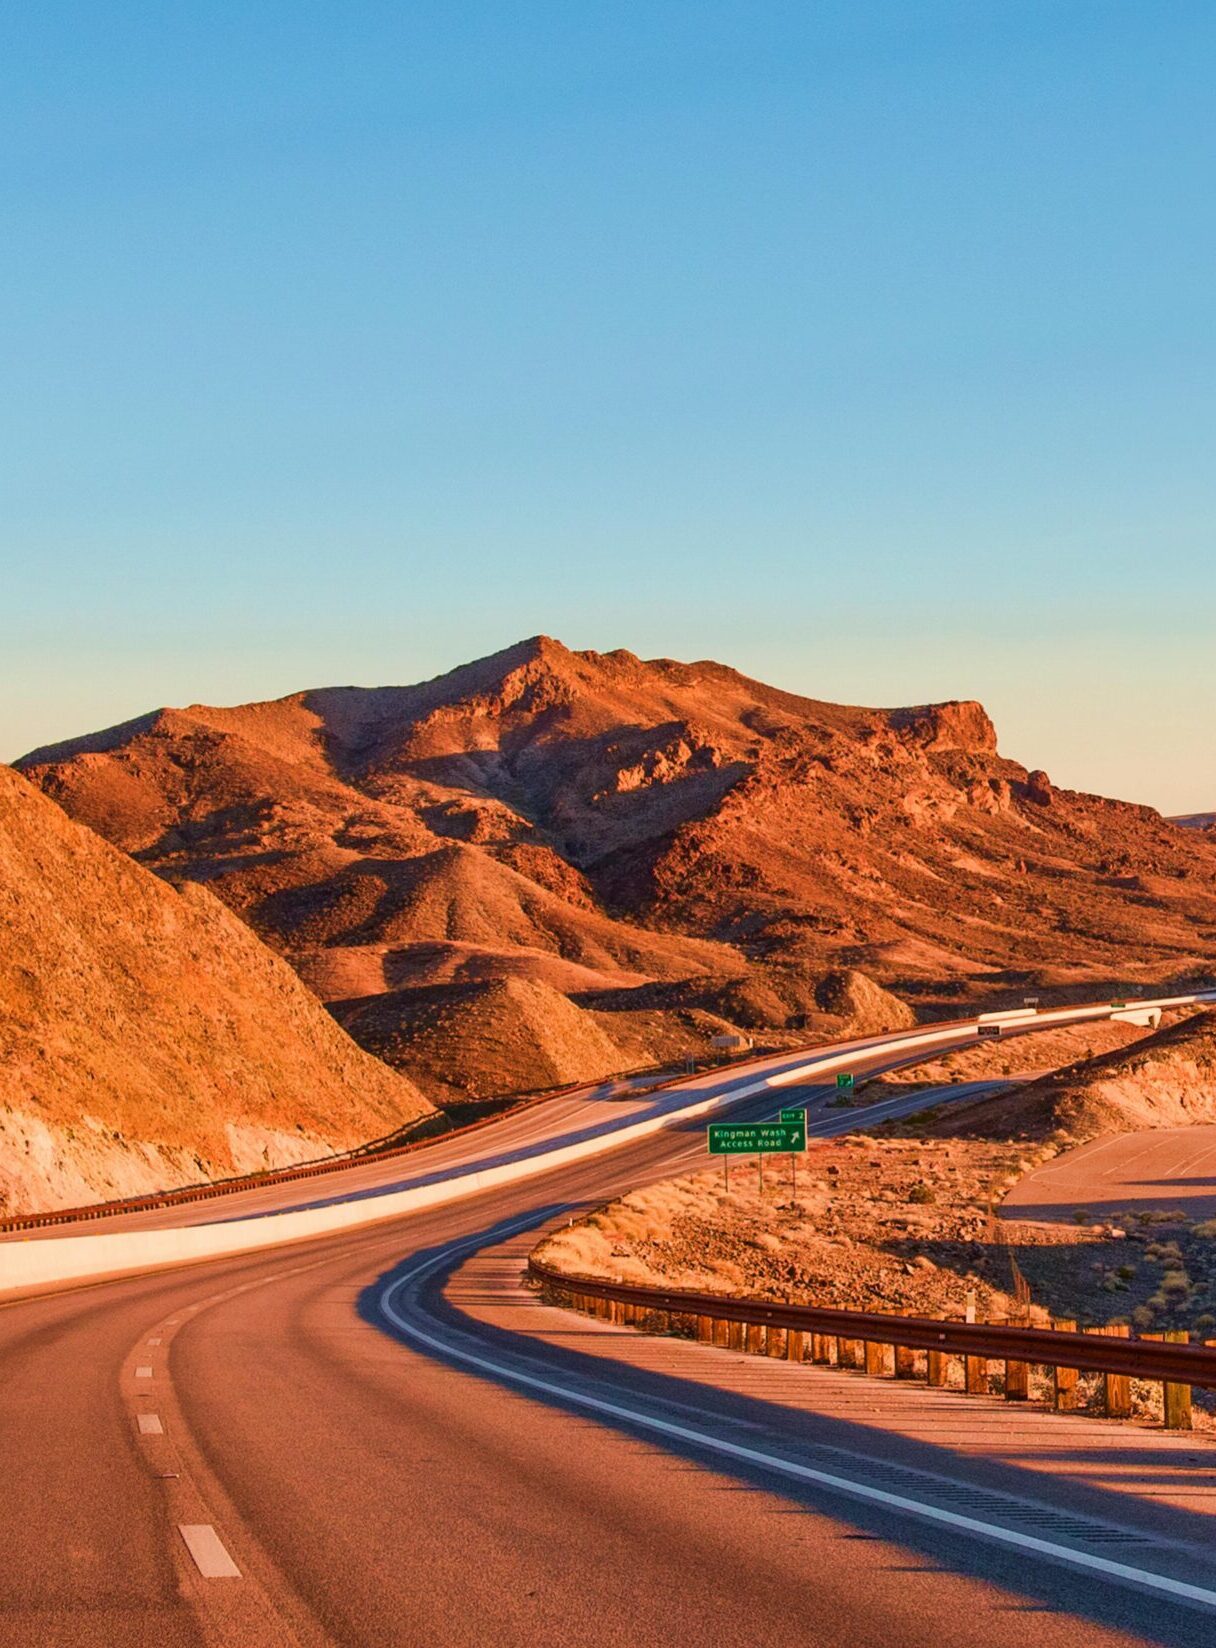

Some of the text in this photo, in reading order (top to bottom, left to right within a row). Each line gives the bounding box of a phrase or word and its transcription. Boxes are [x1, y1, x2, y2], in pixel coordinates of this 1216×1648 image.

[714, 1129, 786, 1139] Kingman Wash
[720, 1139, 782, 1148] Access Road
